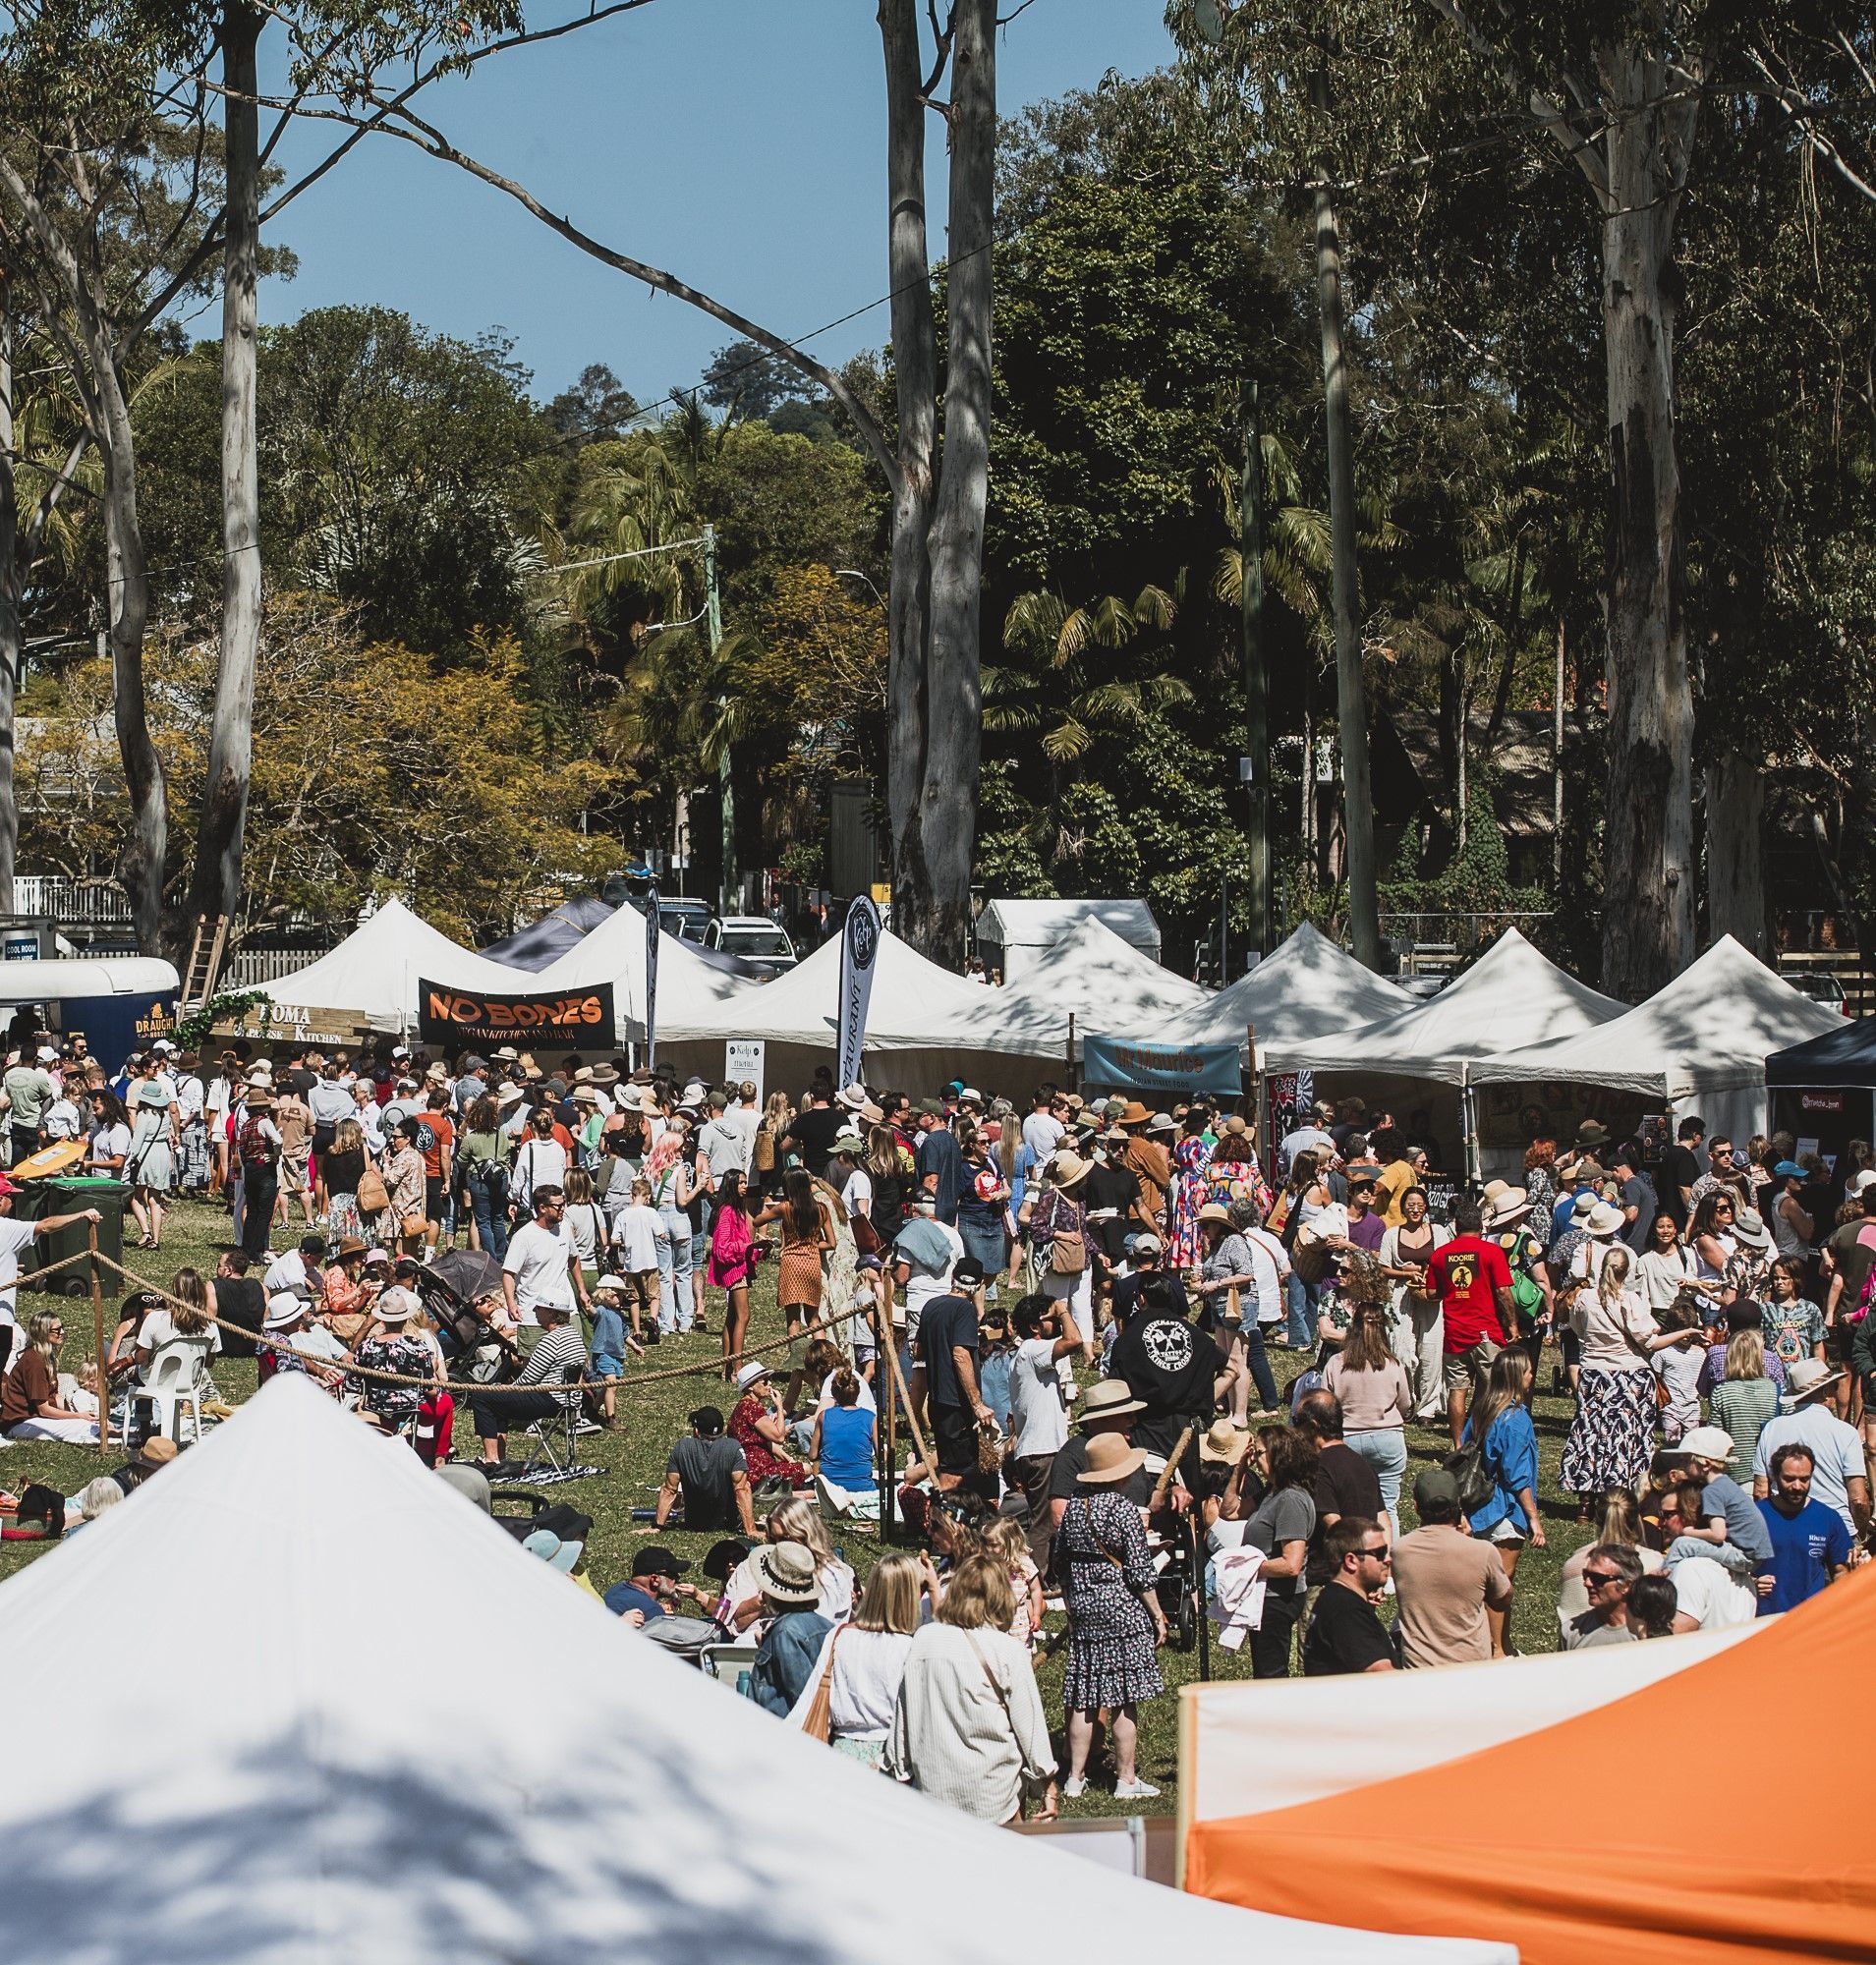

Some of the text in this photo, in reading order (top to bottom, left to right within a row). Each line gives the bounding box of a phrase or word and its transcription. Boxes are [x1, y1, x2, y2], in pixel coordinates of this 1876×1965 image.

[21, 944, 36, 953] ROOM
[429, 991, 602, 1027] NO BONES
[136, 1017, 174, 1034] DRAUGHT
[488, 1029, 529, 1040] KITCHEN
[1137, 1048, 1204, 1073] Maurice
[1448, 1254, 1475, 1263] KOORIE
[1148, 1351, 1192, 1371] KINGS CROSS
